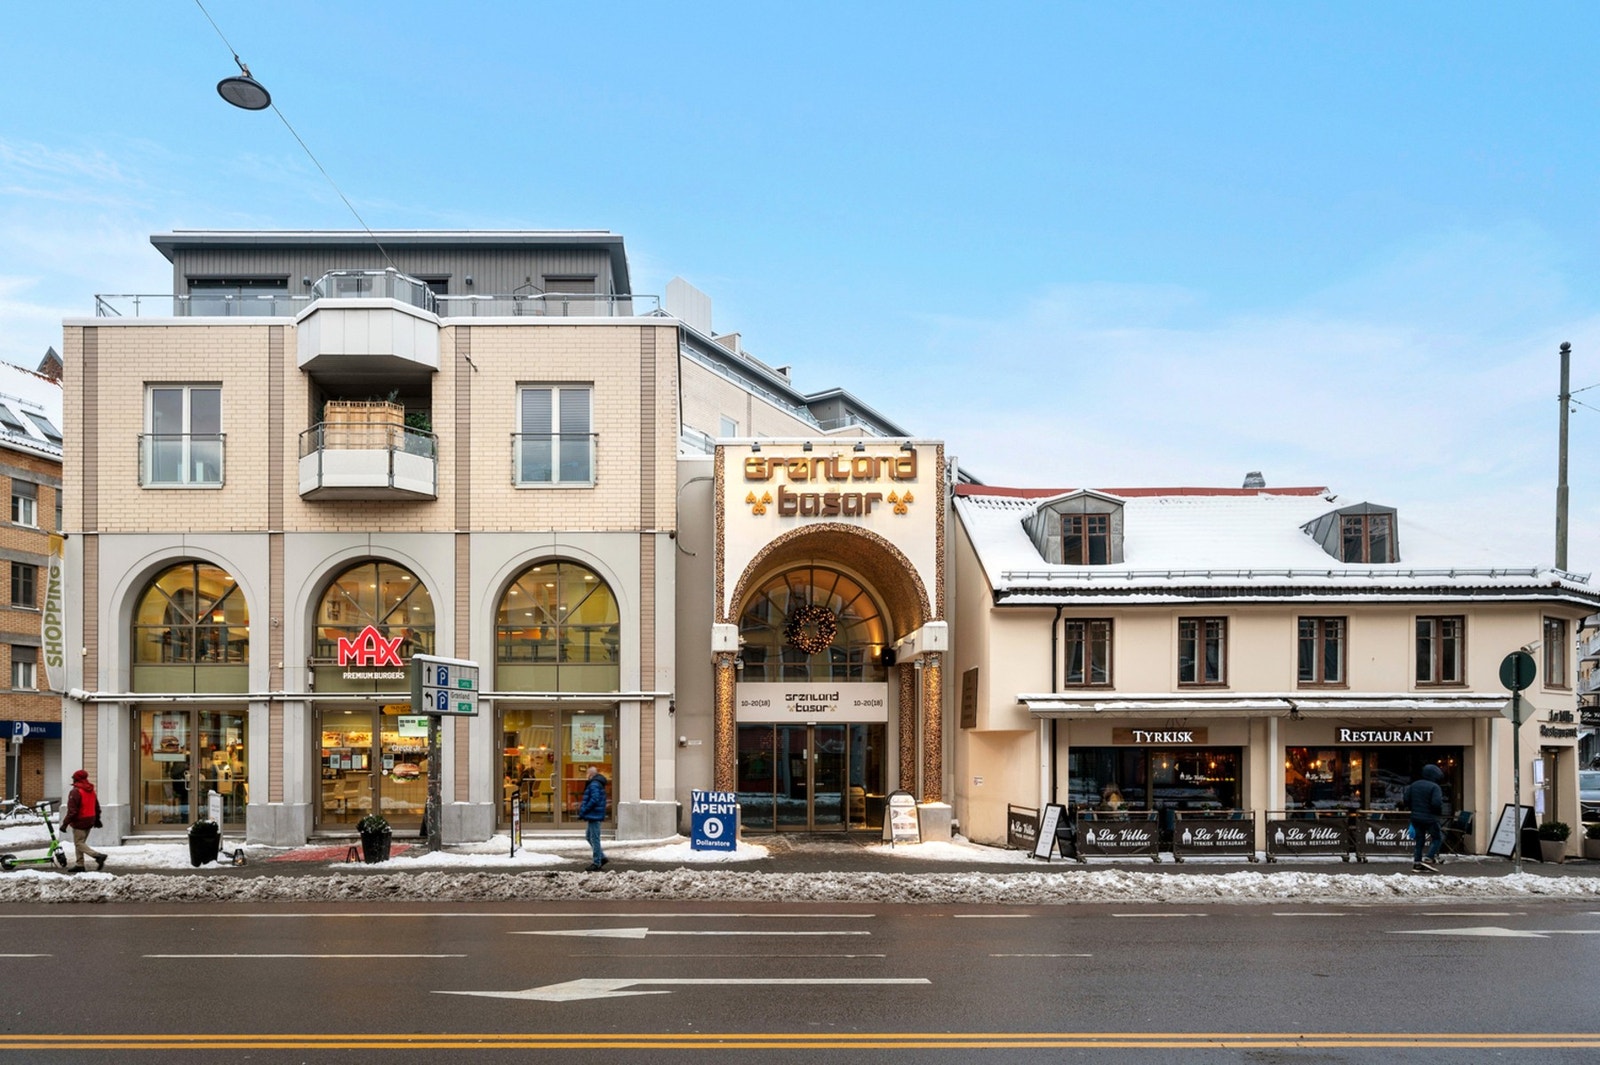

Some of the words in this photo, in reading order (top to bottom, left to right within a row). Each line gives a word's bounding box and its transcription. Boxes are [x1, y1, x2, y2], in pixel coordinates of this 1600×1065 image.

[778, 485, 883, 515] basar
[45, 565, 63, 668] SHOPPING
[337, 624, 404, 667] MAX
[343, 672, 373, 680] PREMIUM
[374, 672, 405, 680] BURGERS
[741, 700, 771, 708] 10-20(18)
[795, 703, 829, 712] basar
[853, 700, 883, 708] 10-20(18)
[1132, 730, 1194, 743] TYRKISK
[1340, 728, 1434, 742] RESTAURANT
[692, 792, 705, 802] VI
[709, 792, 736, 803] HAR
[692, 801, 736, 815] ÅPENT
[1097, 828, 1117, 841] La
[1119, 829, 1151, 841] Villa
[1193, 828, 1214, 840] La
[1215, 828, 1247, 840] Villa
[1286, 828, 1307, 840] La
[1308, 828, 1341, 840] Villa
[1376, 828, 1397, 840] La
[695, 839, 730, 847] Dollarstore
